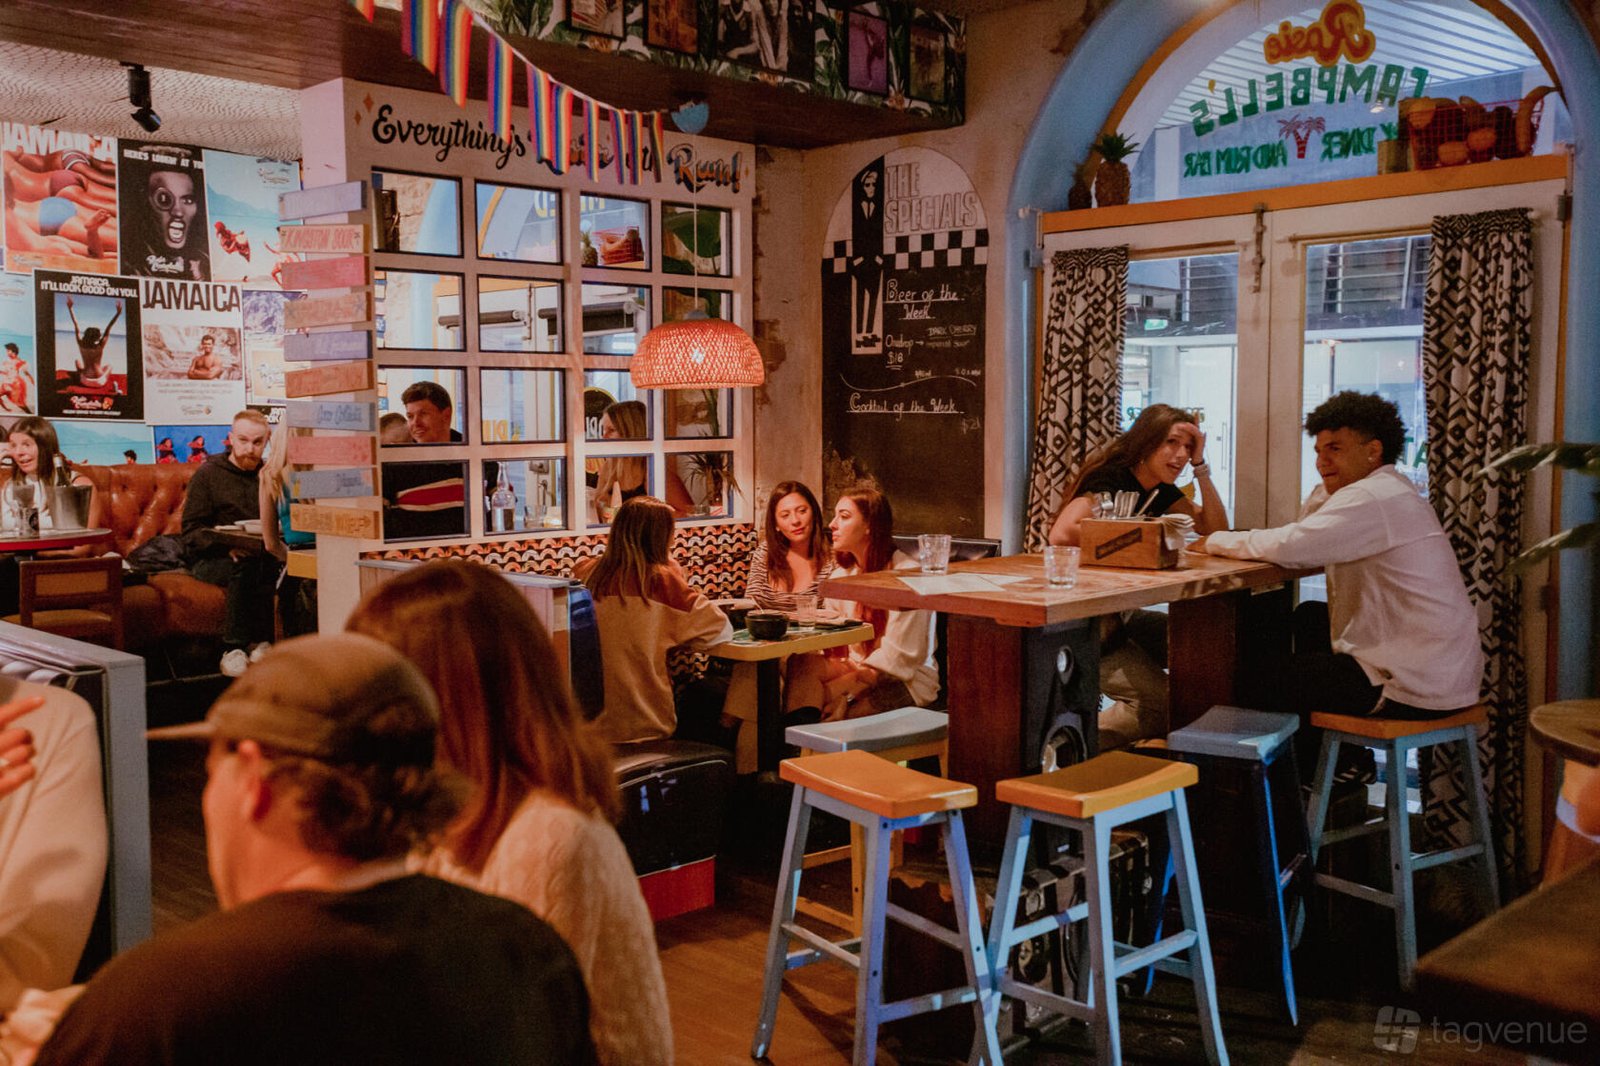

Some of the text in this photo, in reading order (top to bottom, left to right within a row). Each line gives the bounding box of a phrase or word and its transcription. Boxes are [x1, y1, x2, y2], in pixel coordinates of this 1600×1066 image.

[667, 143, 743, 193] Rum!
[885, 161, 920, 199] THE
[884, 190, 978, 234] SPECIALS
[60, 283, 81, 293] LOOK
[82, 285, 105, 295] GOOD
[106, 287, 119, 297] ON
[142, 280, 241, 313] JAMAICA
[886, 278, 958, 307] Beer of the
[903, 303, 931, 319] Week
[849, 392, 955, 422] Cocktail of the Week
